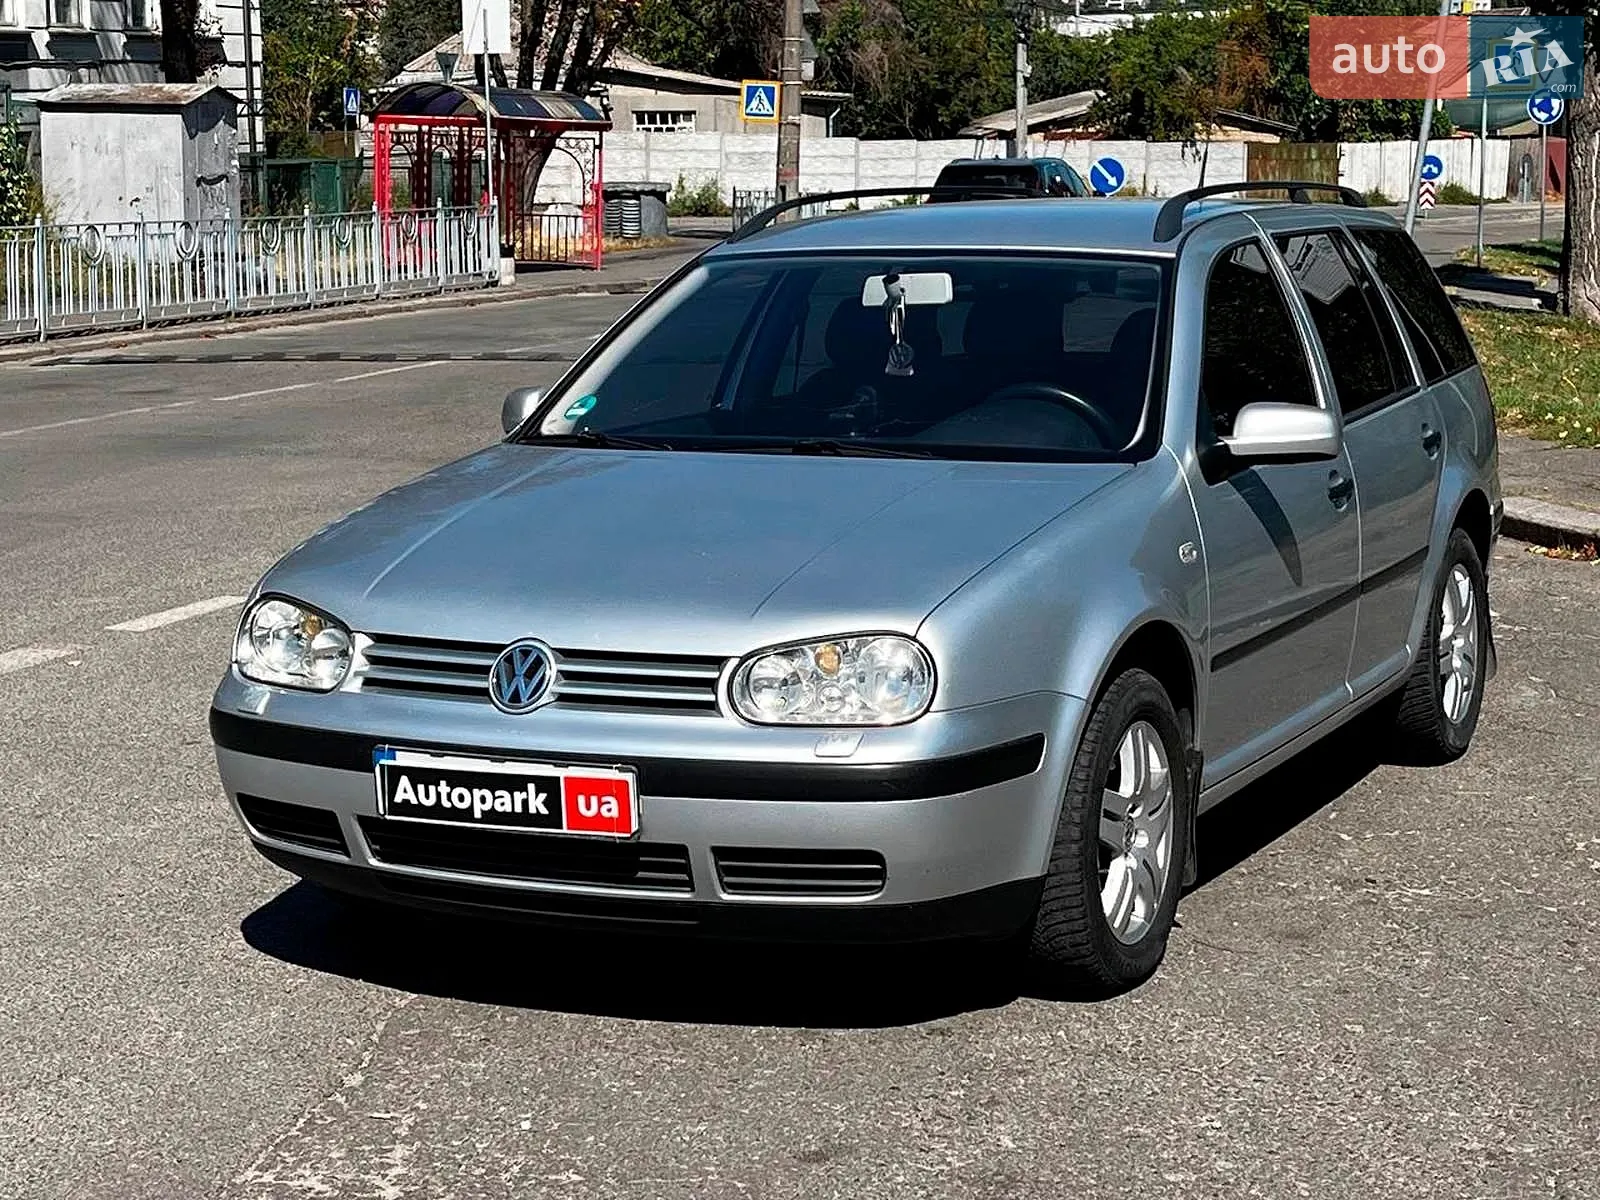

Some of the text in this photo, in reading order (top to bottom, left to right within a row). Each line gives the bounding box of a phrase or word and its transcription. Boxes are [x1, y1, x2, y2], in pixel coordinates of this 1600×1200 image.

[496, 645, 549, 705] VW
[393, 775, 620, 819] Autopark ua
